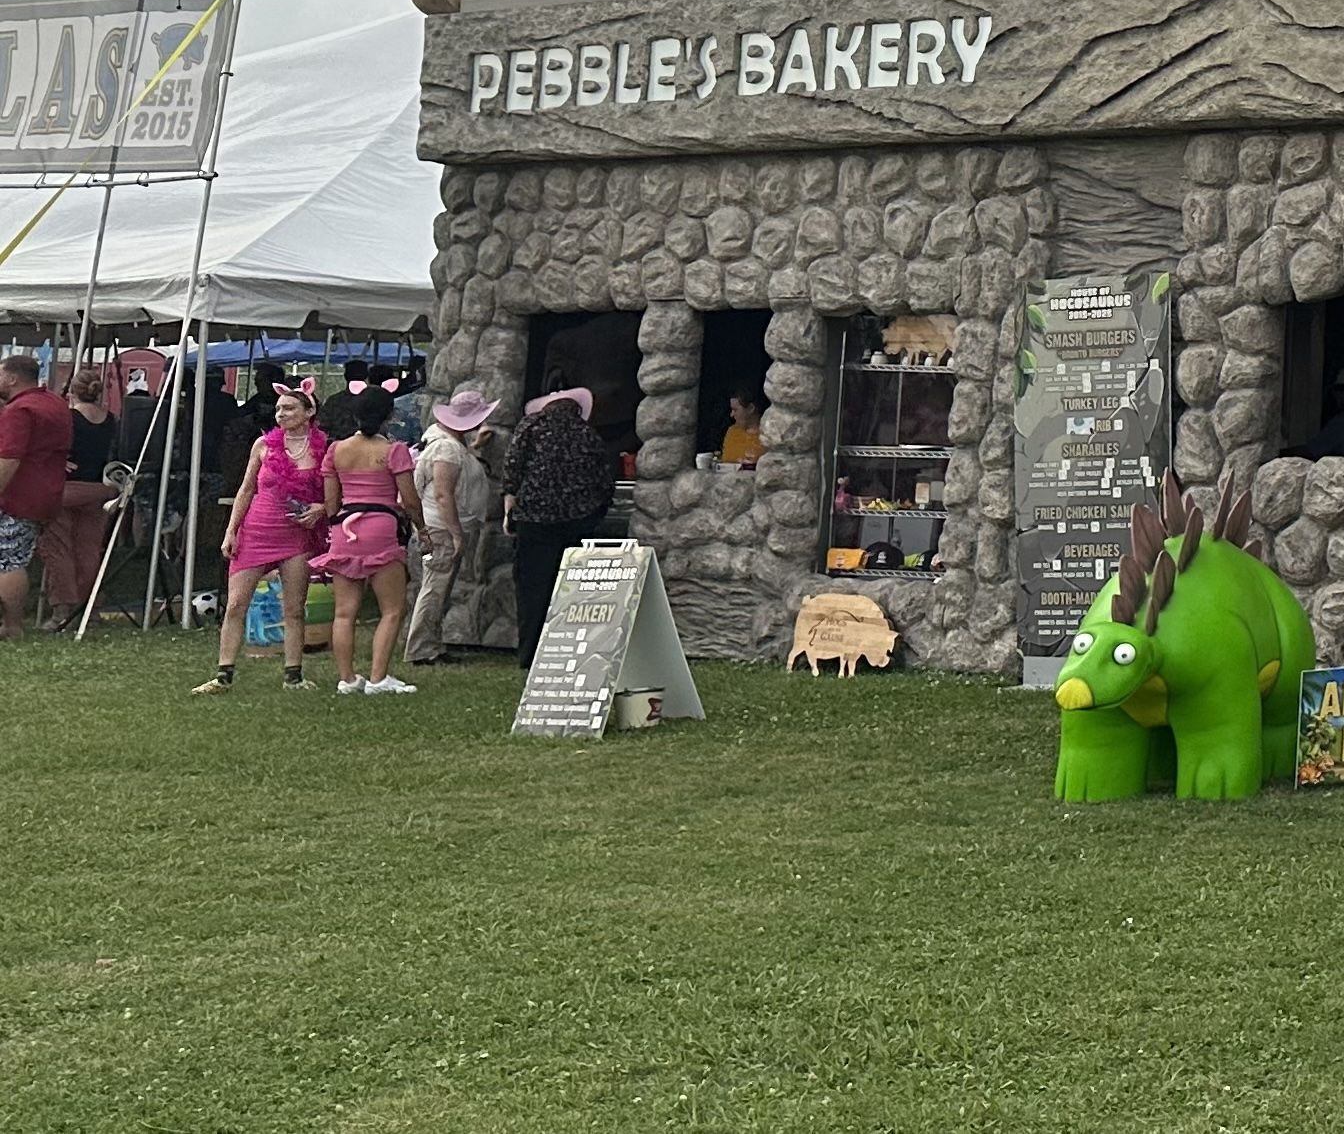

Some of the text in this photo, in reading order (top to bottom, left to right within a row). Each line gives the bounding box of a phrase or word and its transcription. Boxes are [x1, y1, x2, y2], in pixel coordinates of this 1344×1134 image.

[470, 17, 993, 113] PEBBLE'S BAKERY
[141, 79, 193, 107] EST.
[130, 112, 193, 140] 2015
[1050, 294, 1131, 310] HOGOSAURUS
[1046, 330, 1136, 348] SMASH BURGERS
[1063, 397, 1119, 410] TURKEY LEG
[1096, 420, 1112, 432] RIB
[1063, 443, 1120, 457] SHARABLES
[1035, 506, 1131, 520] FRIED CHICKEN SAN
[1064, 544, 1120, 558] BEVERAGES
[567, 568, 637, 580] HOGOSAURUS
[566, 604, 616, 623] BAKERY
